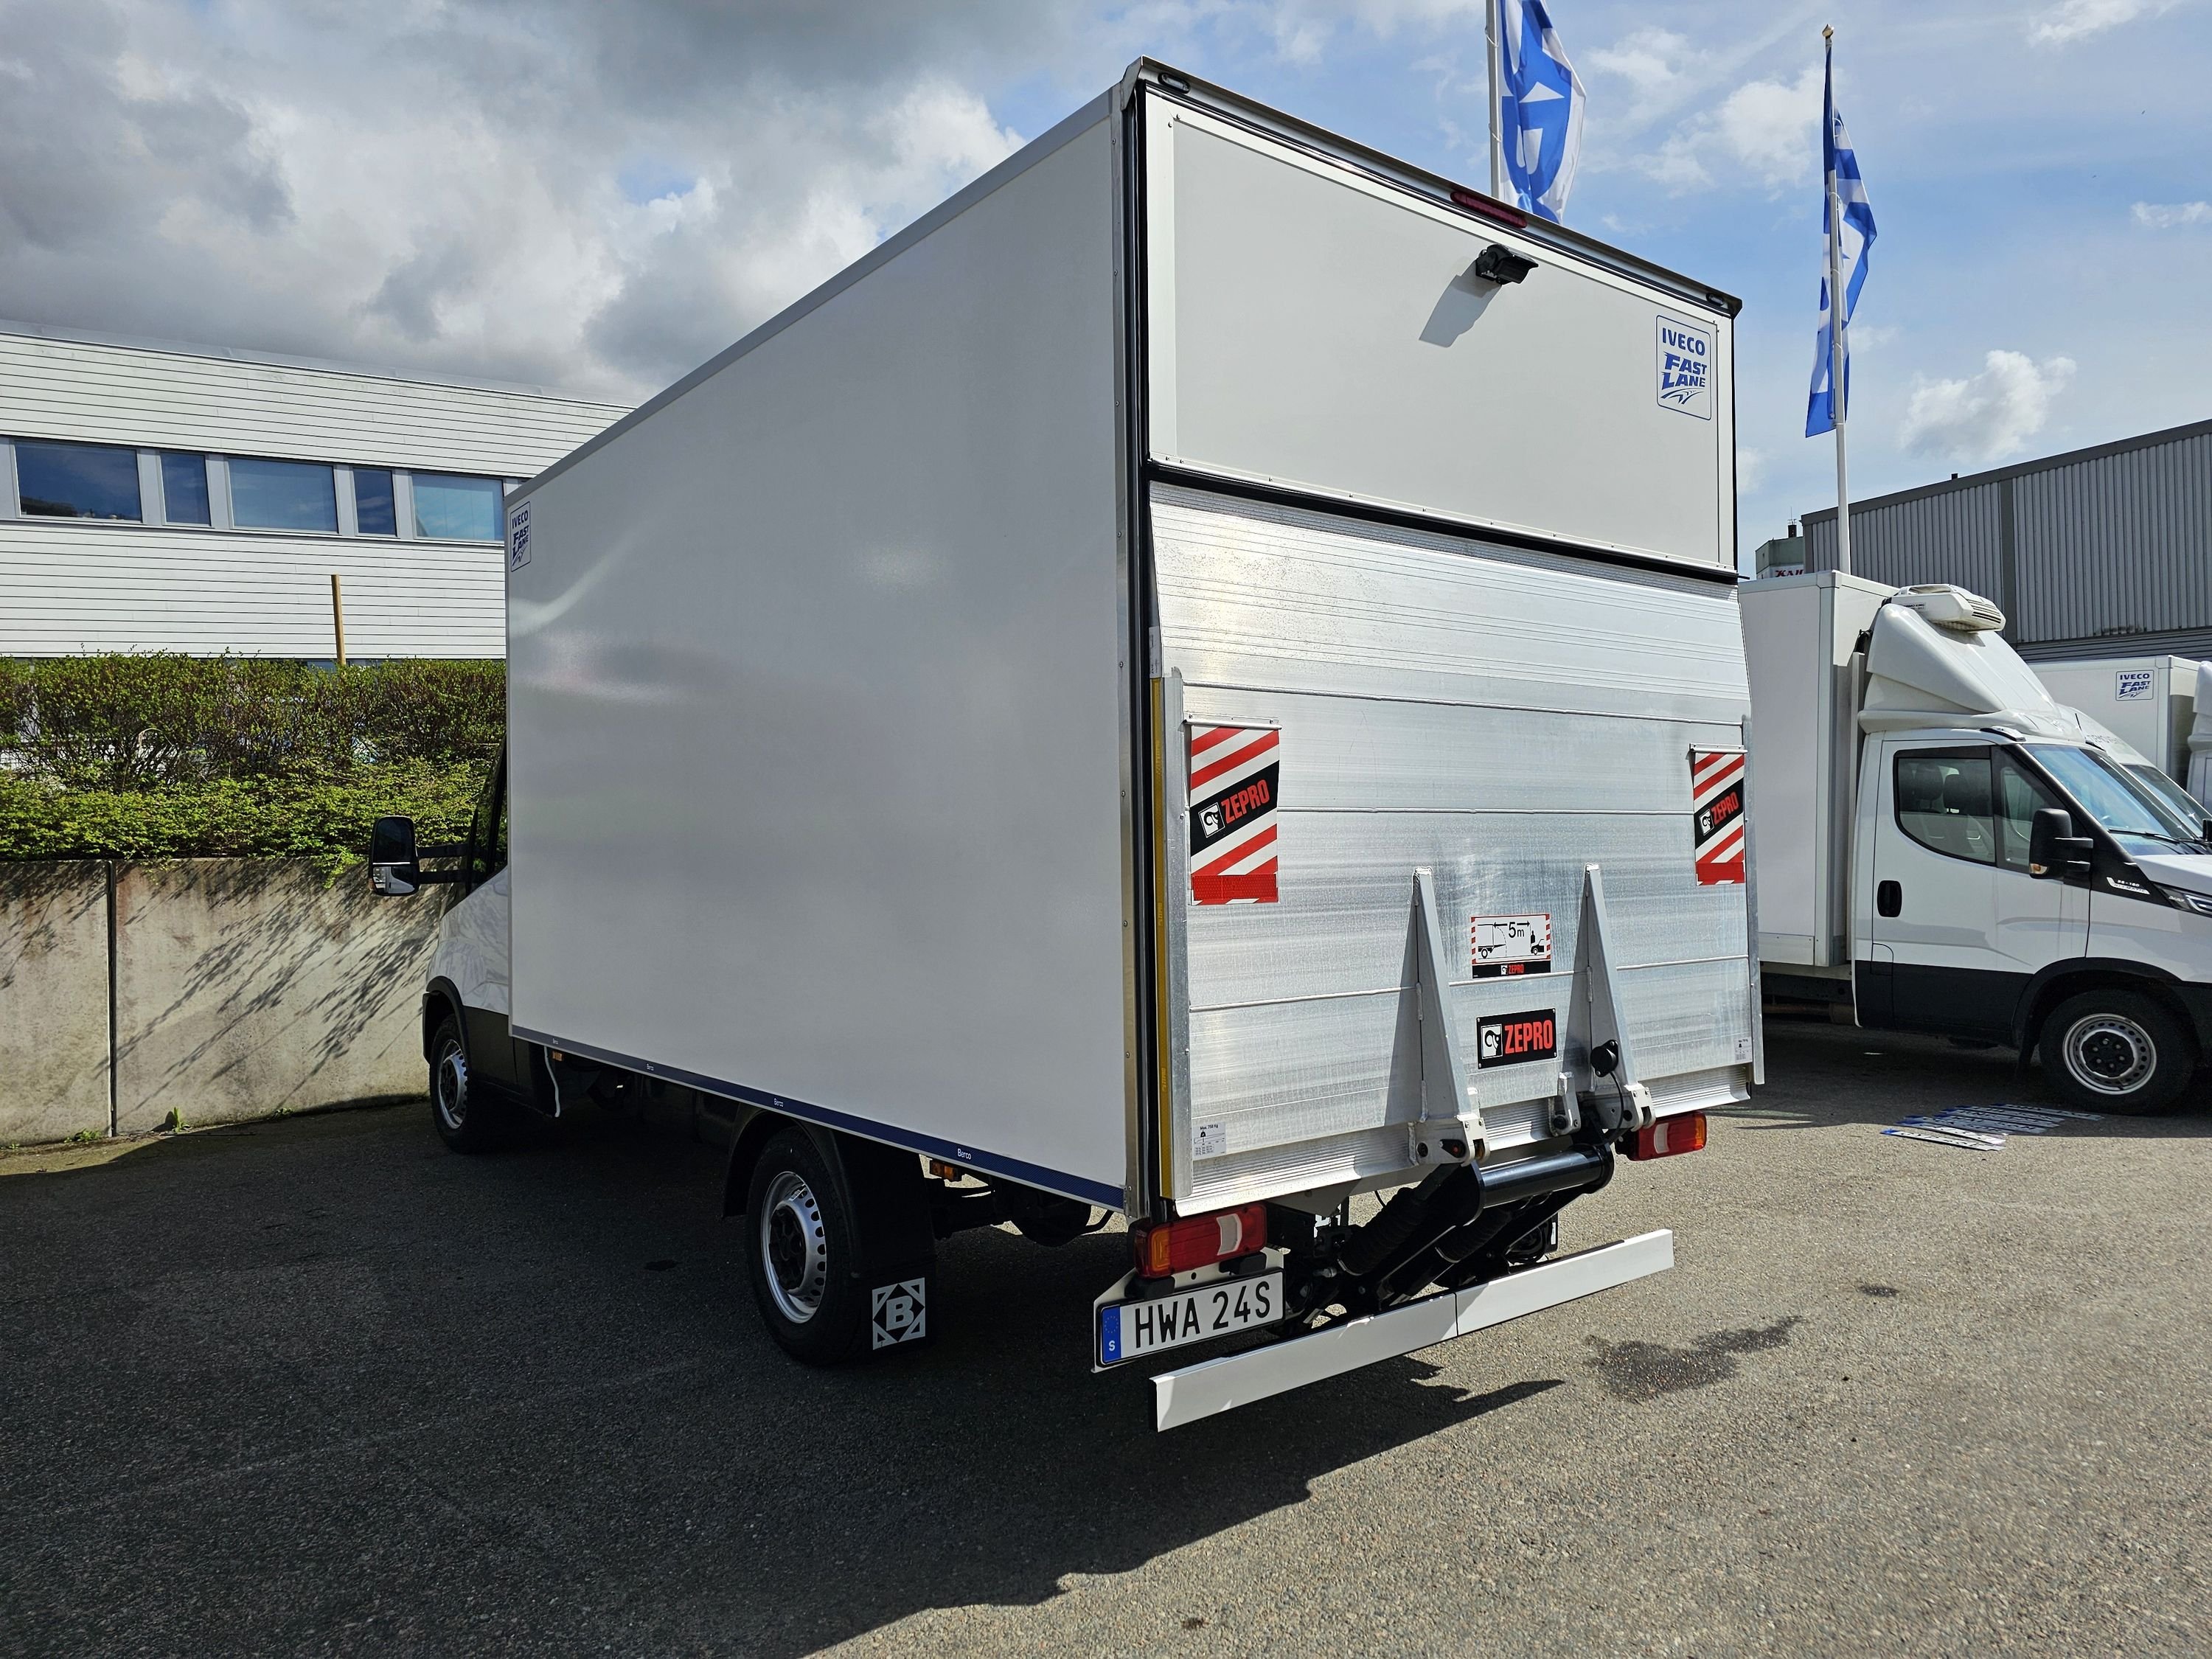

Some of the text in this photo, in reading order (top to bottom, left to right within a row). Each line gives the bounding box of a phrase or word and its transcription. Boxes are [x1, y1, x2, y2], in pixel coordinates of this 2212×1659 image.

[1662, 327, 1705, 356] IVECO
[1663, 351, 1708, 375] FAST
[1661, 372, 1706, 391] LANE
[512, 509, 529, 529] IVECO
[513, 524, 529, 546] FAST
[512, 535, 529, 561] LANE
[2118, 686, 2150, 695] LANE
[2121, 681, 2152, 689] FAST
[1221, 779, 1270, 824] ZEPRO
[1711, 791, 1739, 825] ZEPRO
[1508, 963, 1525, 975] ZEPRO
[1504, 1019, 1553, 1054] ZEPRO
[957, 1148, 972, 1160] Berco
[886, 1295, 914, 1332] B
[1108, 1281, 1270, 1352] S HWA 24S
